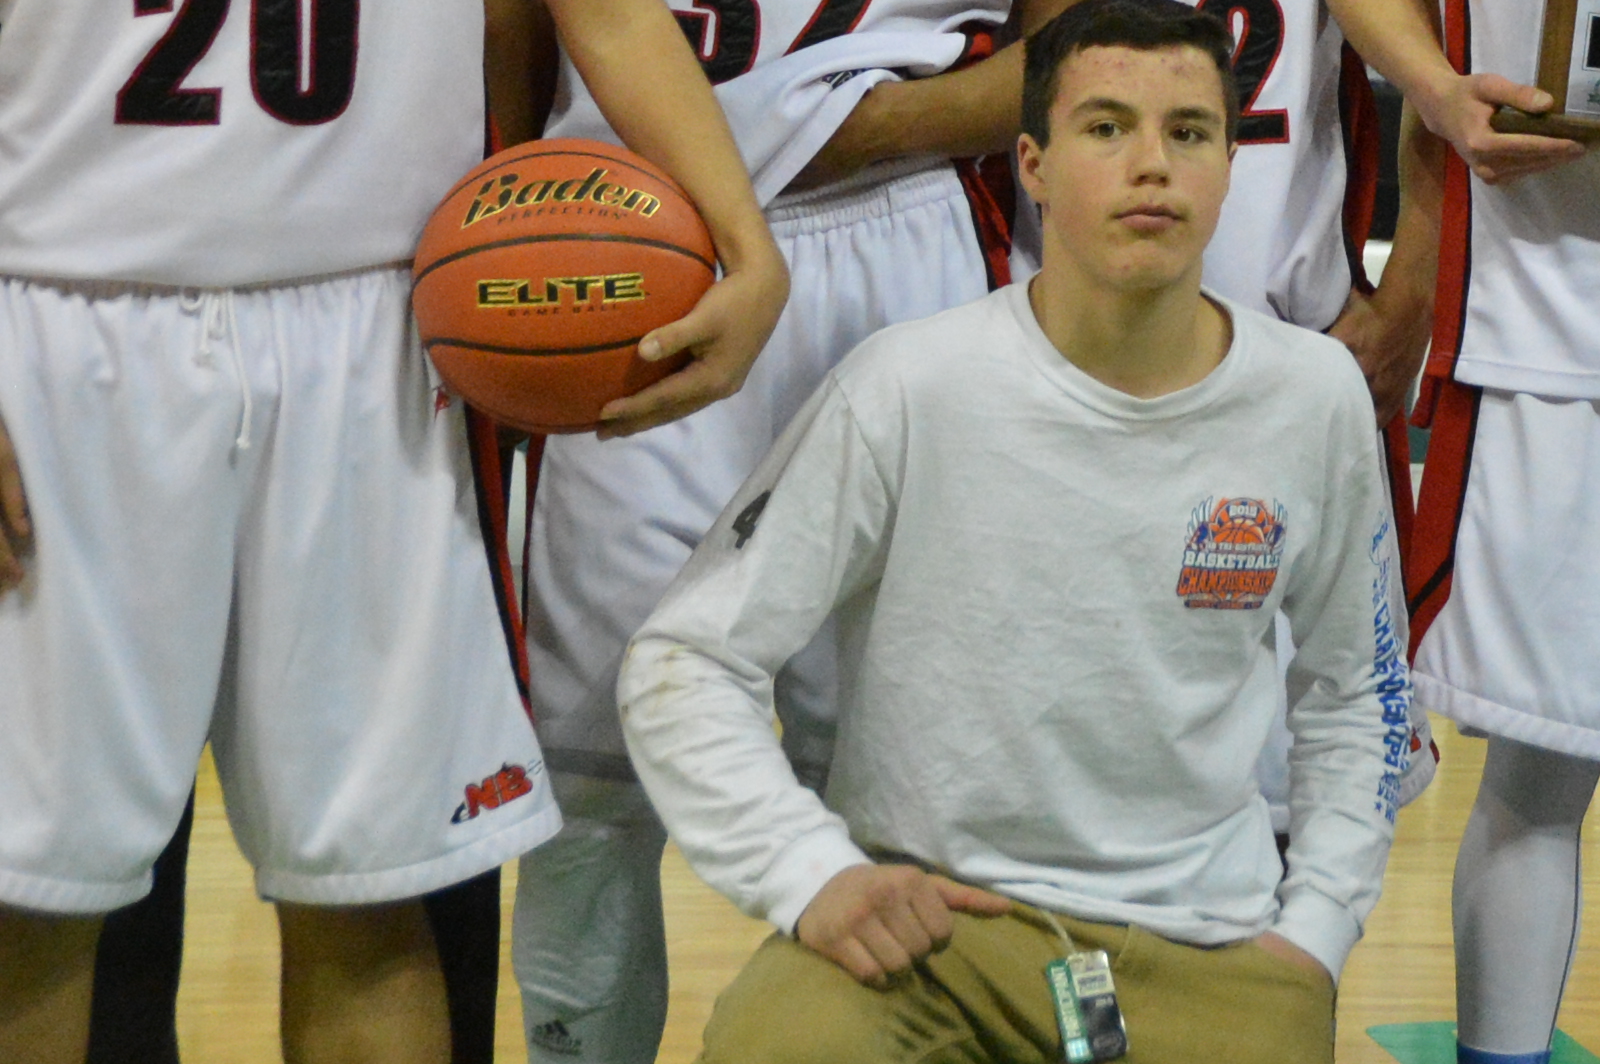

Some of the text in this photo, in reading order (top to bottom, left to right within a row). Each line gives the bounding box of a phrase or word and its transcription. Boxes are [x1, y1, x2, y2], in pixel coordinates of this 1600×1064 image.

[460, 167, 662, 230] Baden
[476, 272, 645, 308] ELITE
[508, 304, 616, 316] GAME BALL
[1184, 550, 1280, 570] BASKETBALL
